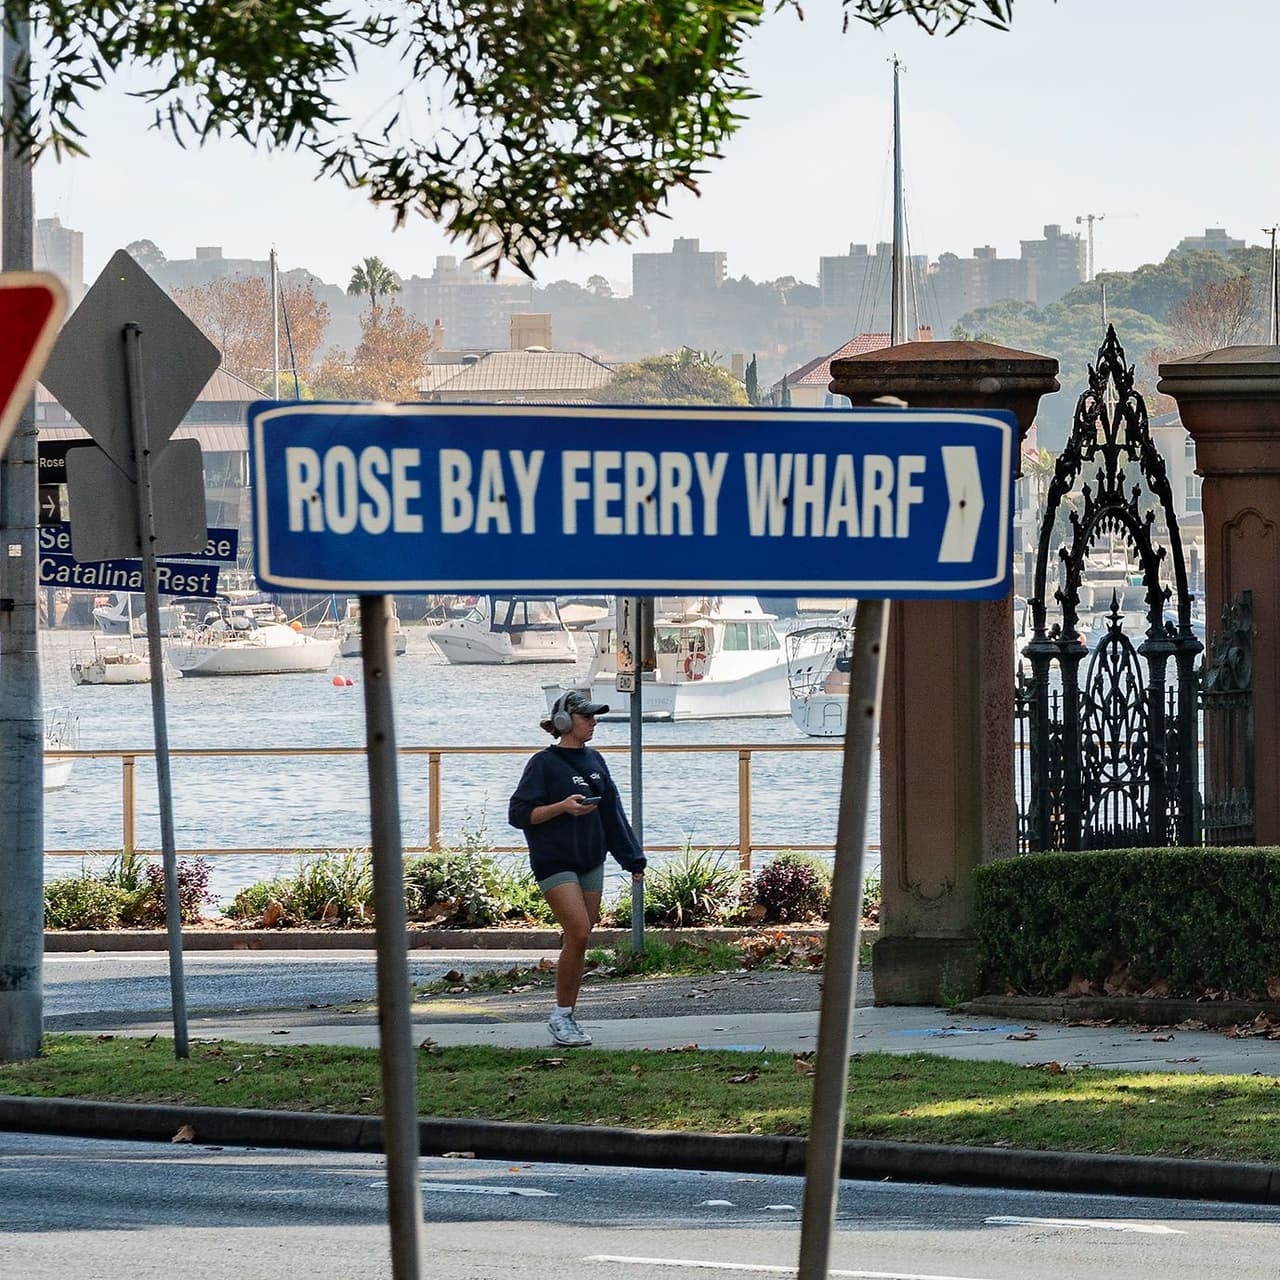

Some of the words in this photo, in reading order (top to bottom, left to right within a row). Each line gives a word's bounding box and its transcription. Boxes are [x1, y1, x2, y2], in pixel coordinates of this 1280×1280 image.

[39, 457, 65, 468] Rose
[285, 445, 424, 535] ROSE
[439, 448, 545, 535] BAY
[562, 450, 729, 536] FERRY
[744, 452, 927, 538] WHARF
[39, 558, 143, 588] Catalina
[156, 567, 211, 593] Rest
